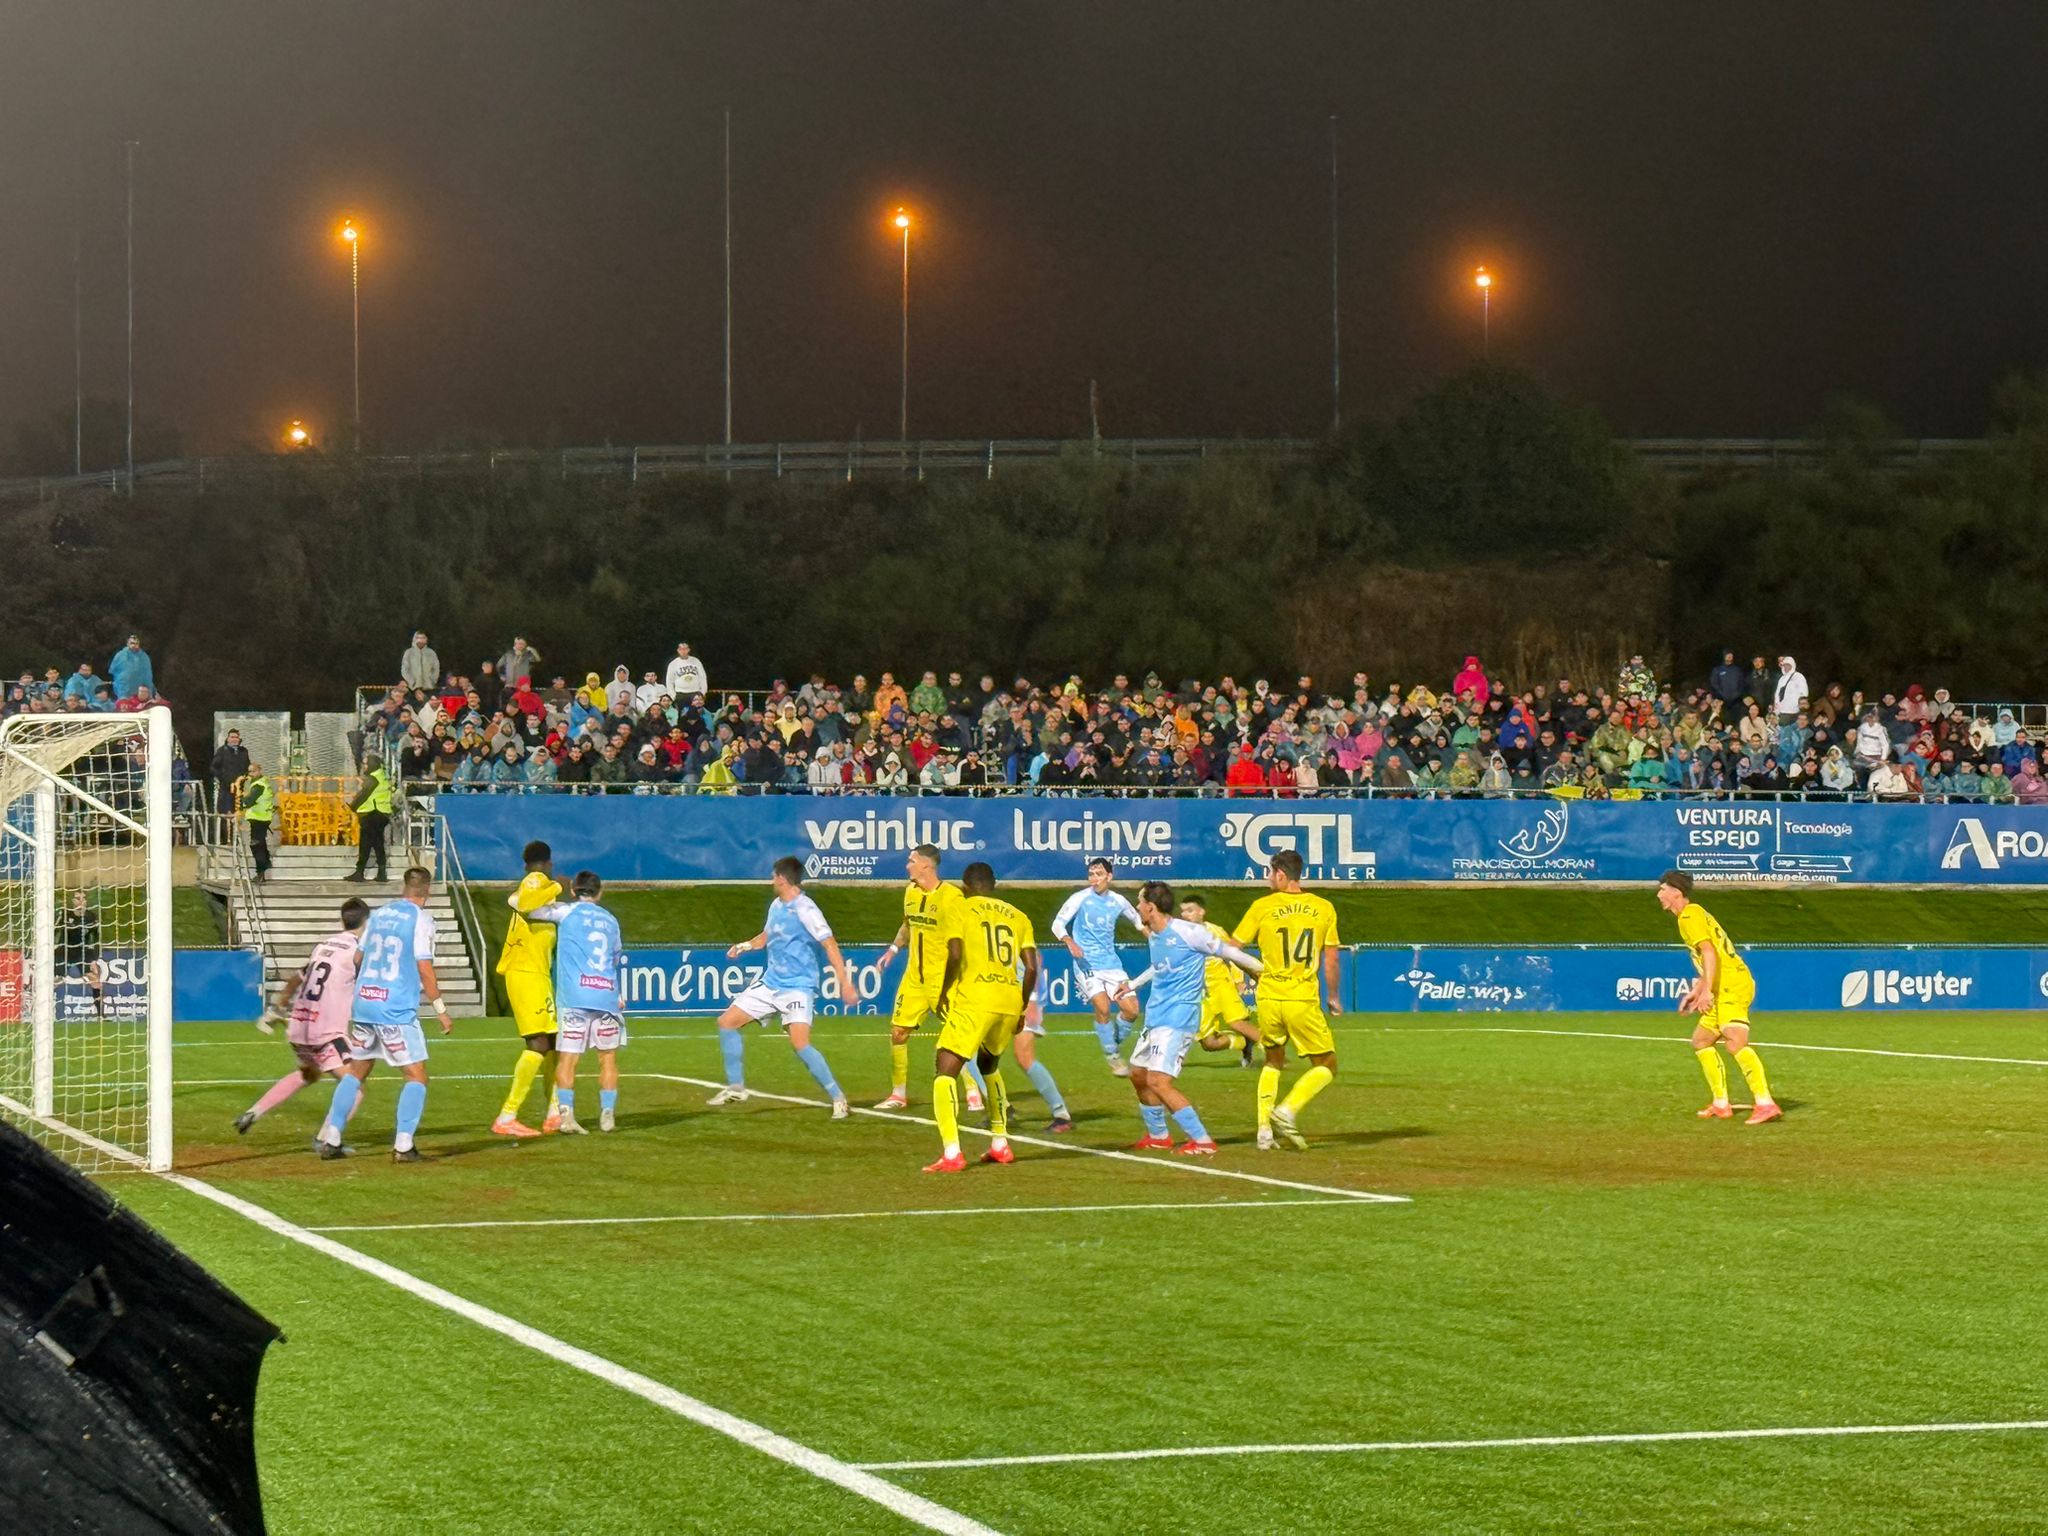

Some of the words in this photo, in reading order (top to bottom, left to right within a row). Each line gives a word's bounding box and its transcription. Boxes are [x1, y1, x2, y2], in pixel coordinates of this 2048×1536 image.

[804, 807, 975, 850] veinluc
[1676, 809, 1773, 826] VENTURA
[1784, 821, 1852, 837] Tecnología
[1245, 814, 1376, 866] GTL
[1689, 830, 1760, 849] ESPEJO
[822, 857, 879, 865] RENAULT
[823, 867, 873, 875] TRUCKS
[1132, 856, 1172, 868] parts
[1244, 867, 1376, 880] ALUILER
[363, 933, 403, 981] 23
[586, 931, 608, 971] 3
[981, 921, 1013, 966] 16
[1275, 927, 1314, 969] 14
[300, 961, 331, 1001] 13
[1874, 970, 1972, 1003] Keyter
